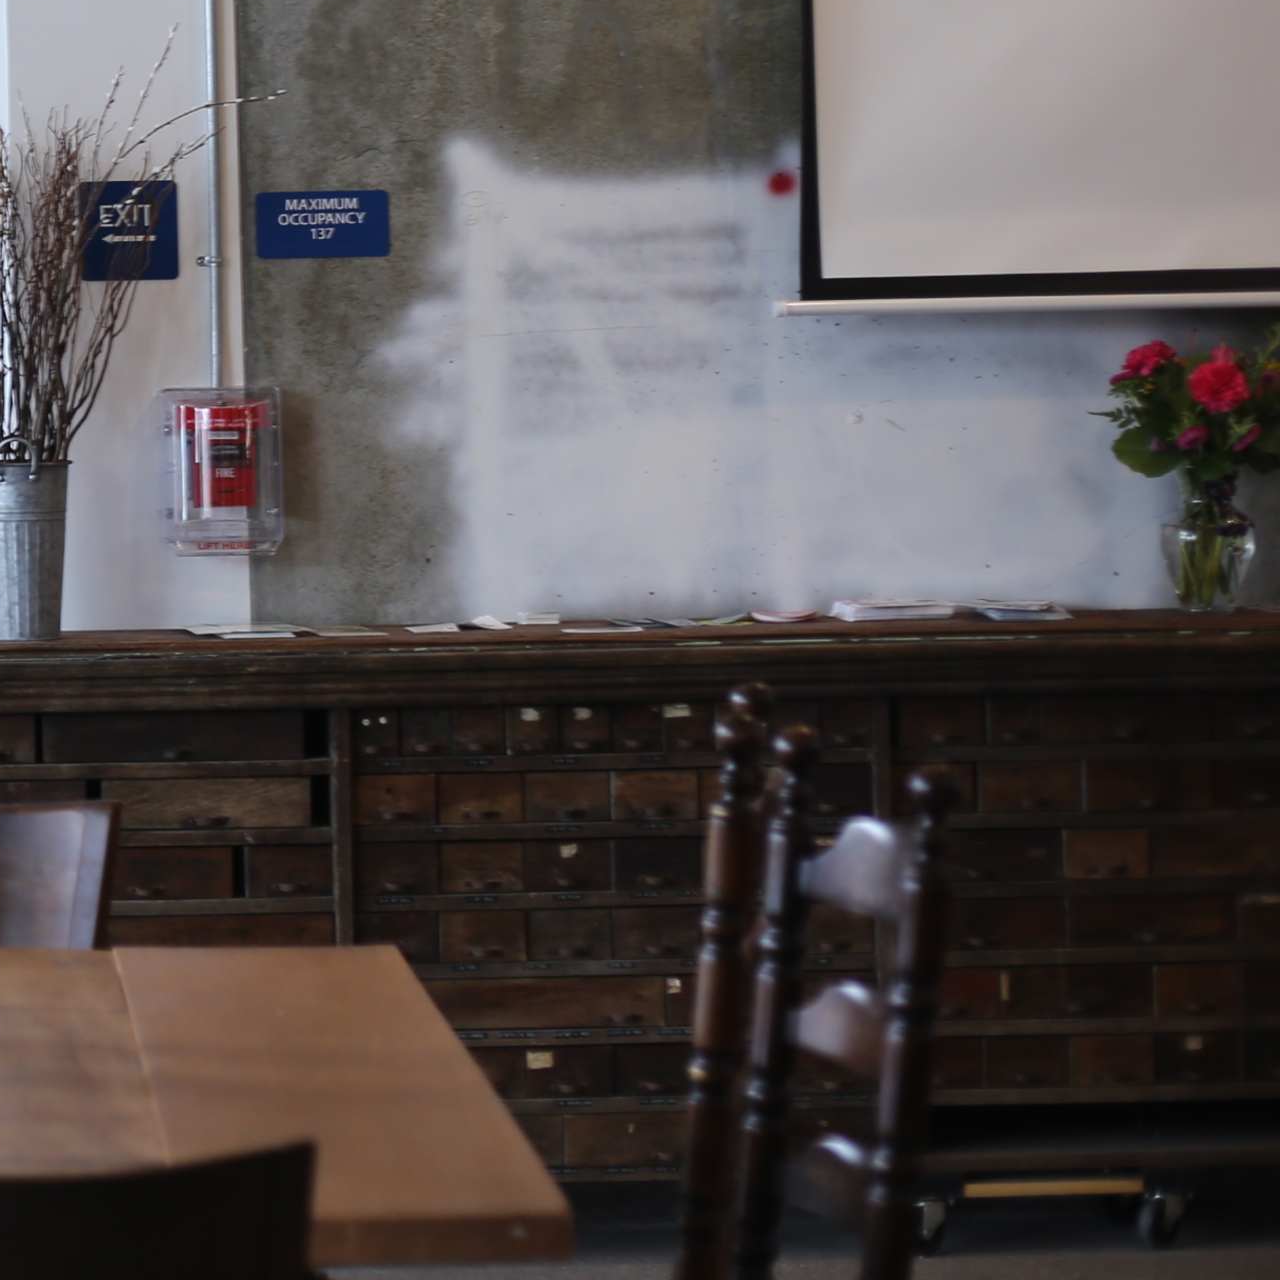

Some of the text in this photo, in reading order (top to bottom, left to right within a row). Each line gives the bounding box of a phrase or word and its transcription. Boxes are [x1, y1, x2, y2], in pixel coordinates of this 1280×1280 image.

[284, 197, 359, 212] MAXIMUM
[99, 203, 151, 228] EXIT
[277, 211, 366, 226] OCCUPANCY
[309, 227, 335, 240] 137
